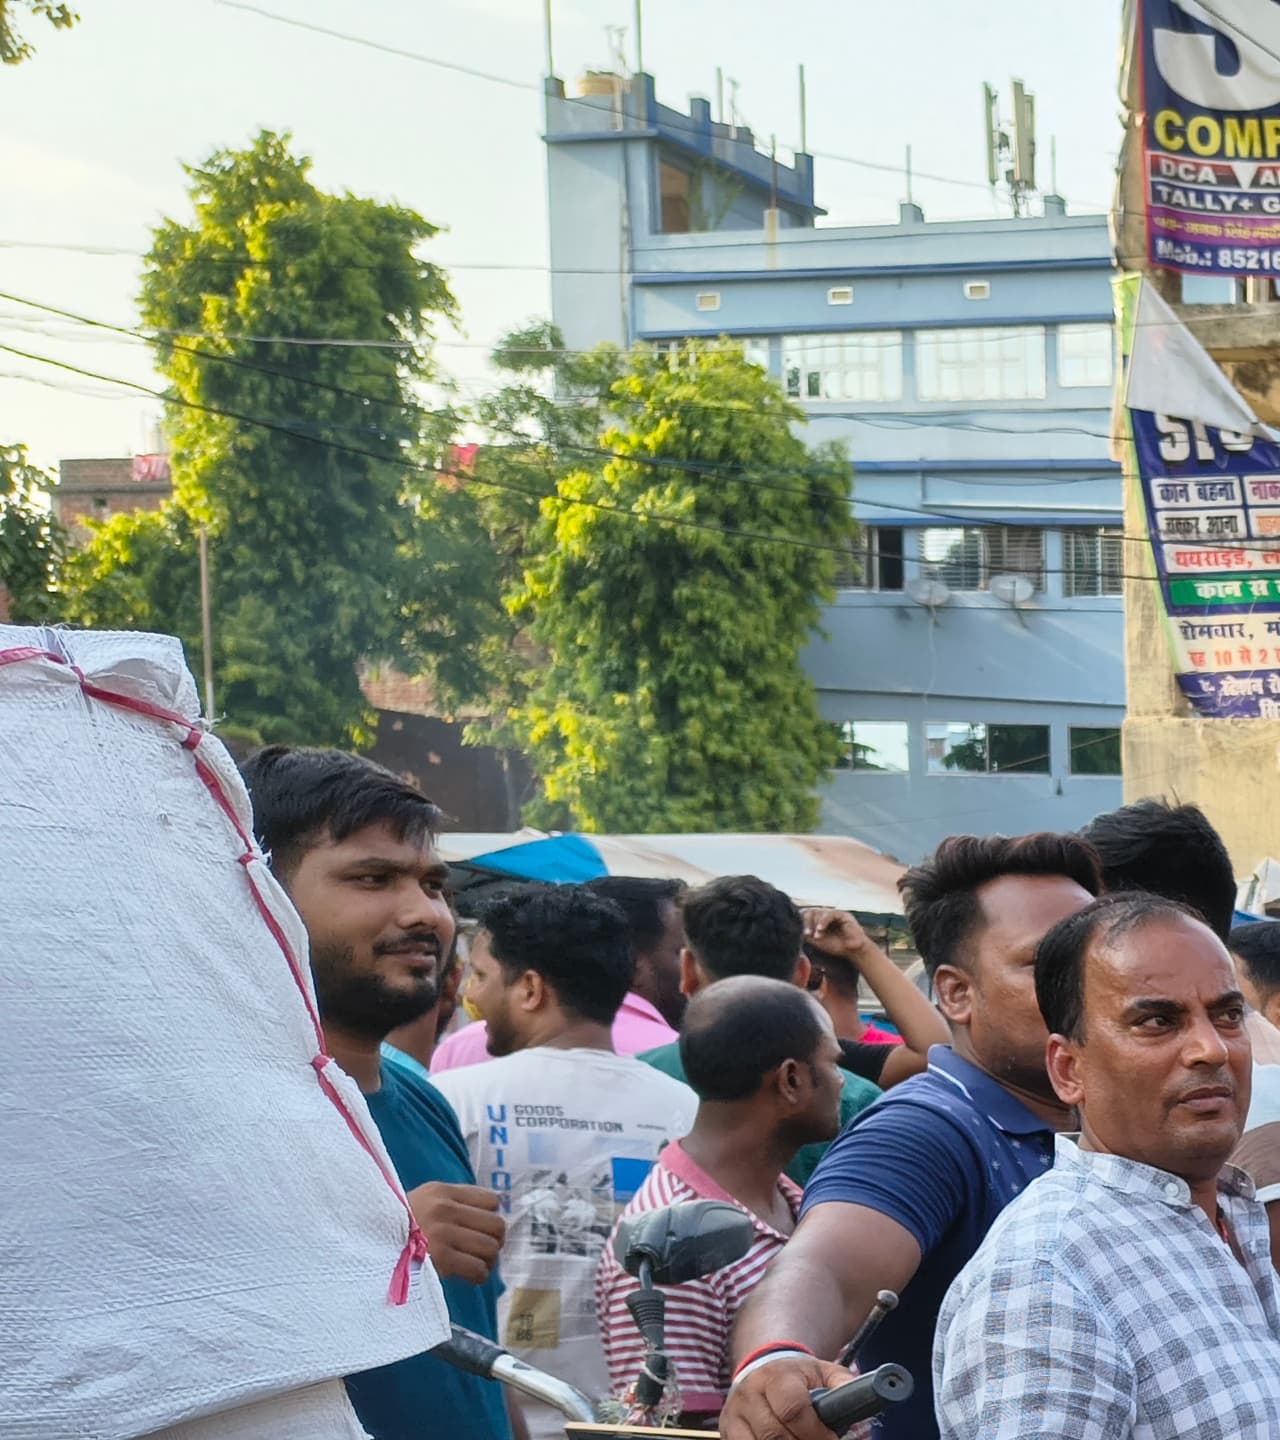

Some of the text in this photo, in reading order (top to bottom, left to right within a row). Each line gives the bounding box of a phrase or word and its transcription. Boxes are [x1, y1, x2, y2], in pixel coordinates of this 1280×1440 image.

[1159, 159, 1217, 184] DCA
[1157, 483, 1190, 502] कान
[1193, 580, 1242, 599] कान
[1215, 650, 1232, 666] 10
[514, 1104, 565, 1117] GOODS
[515, 1116, 624, 1133] CORPORATION
[487, 1104, 512, 1214] UNION
